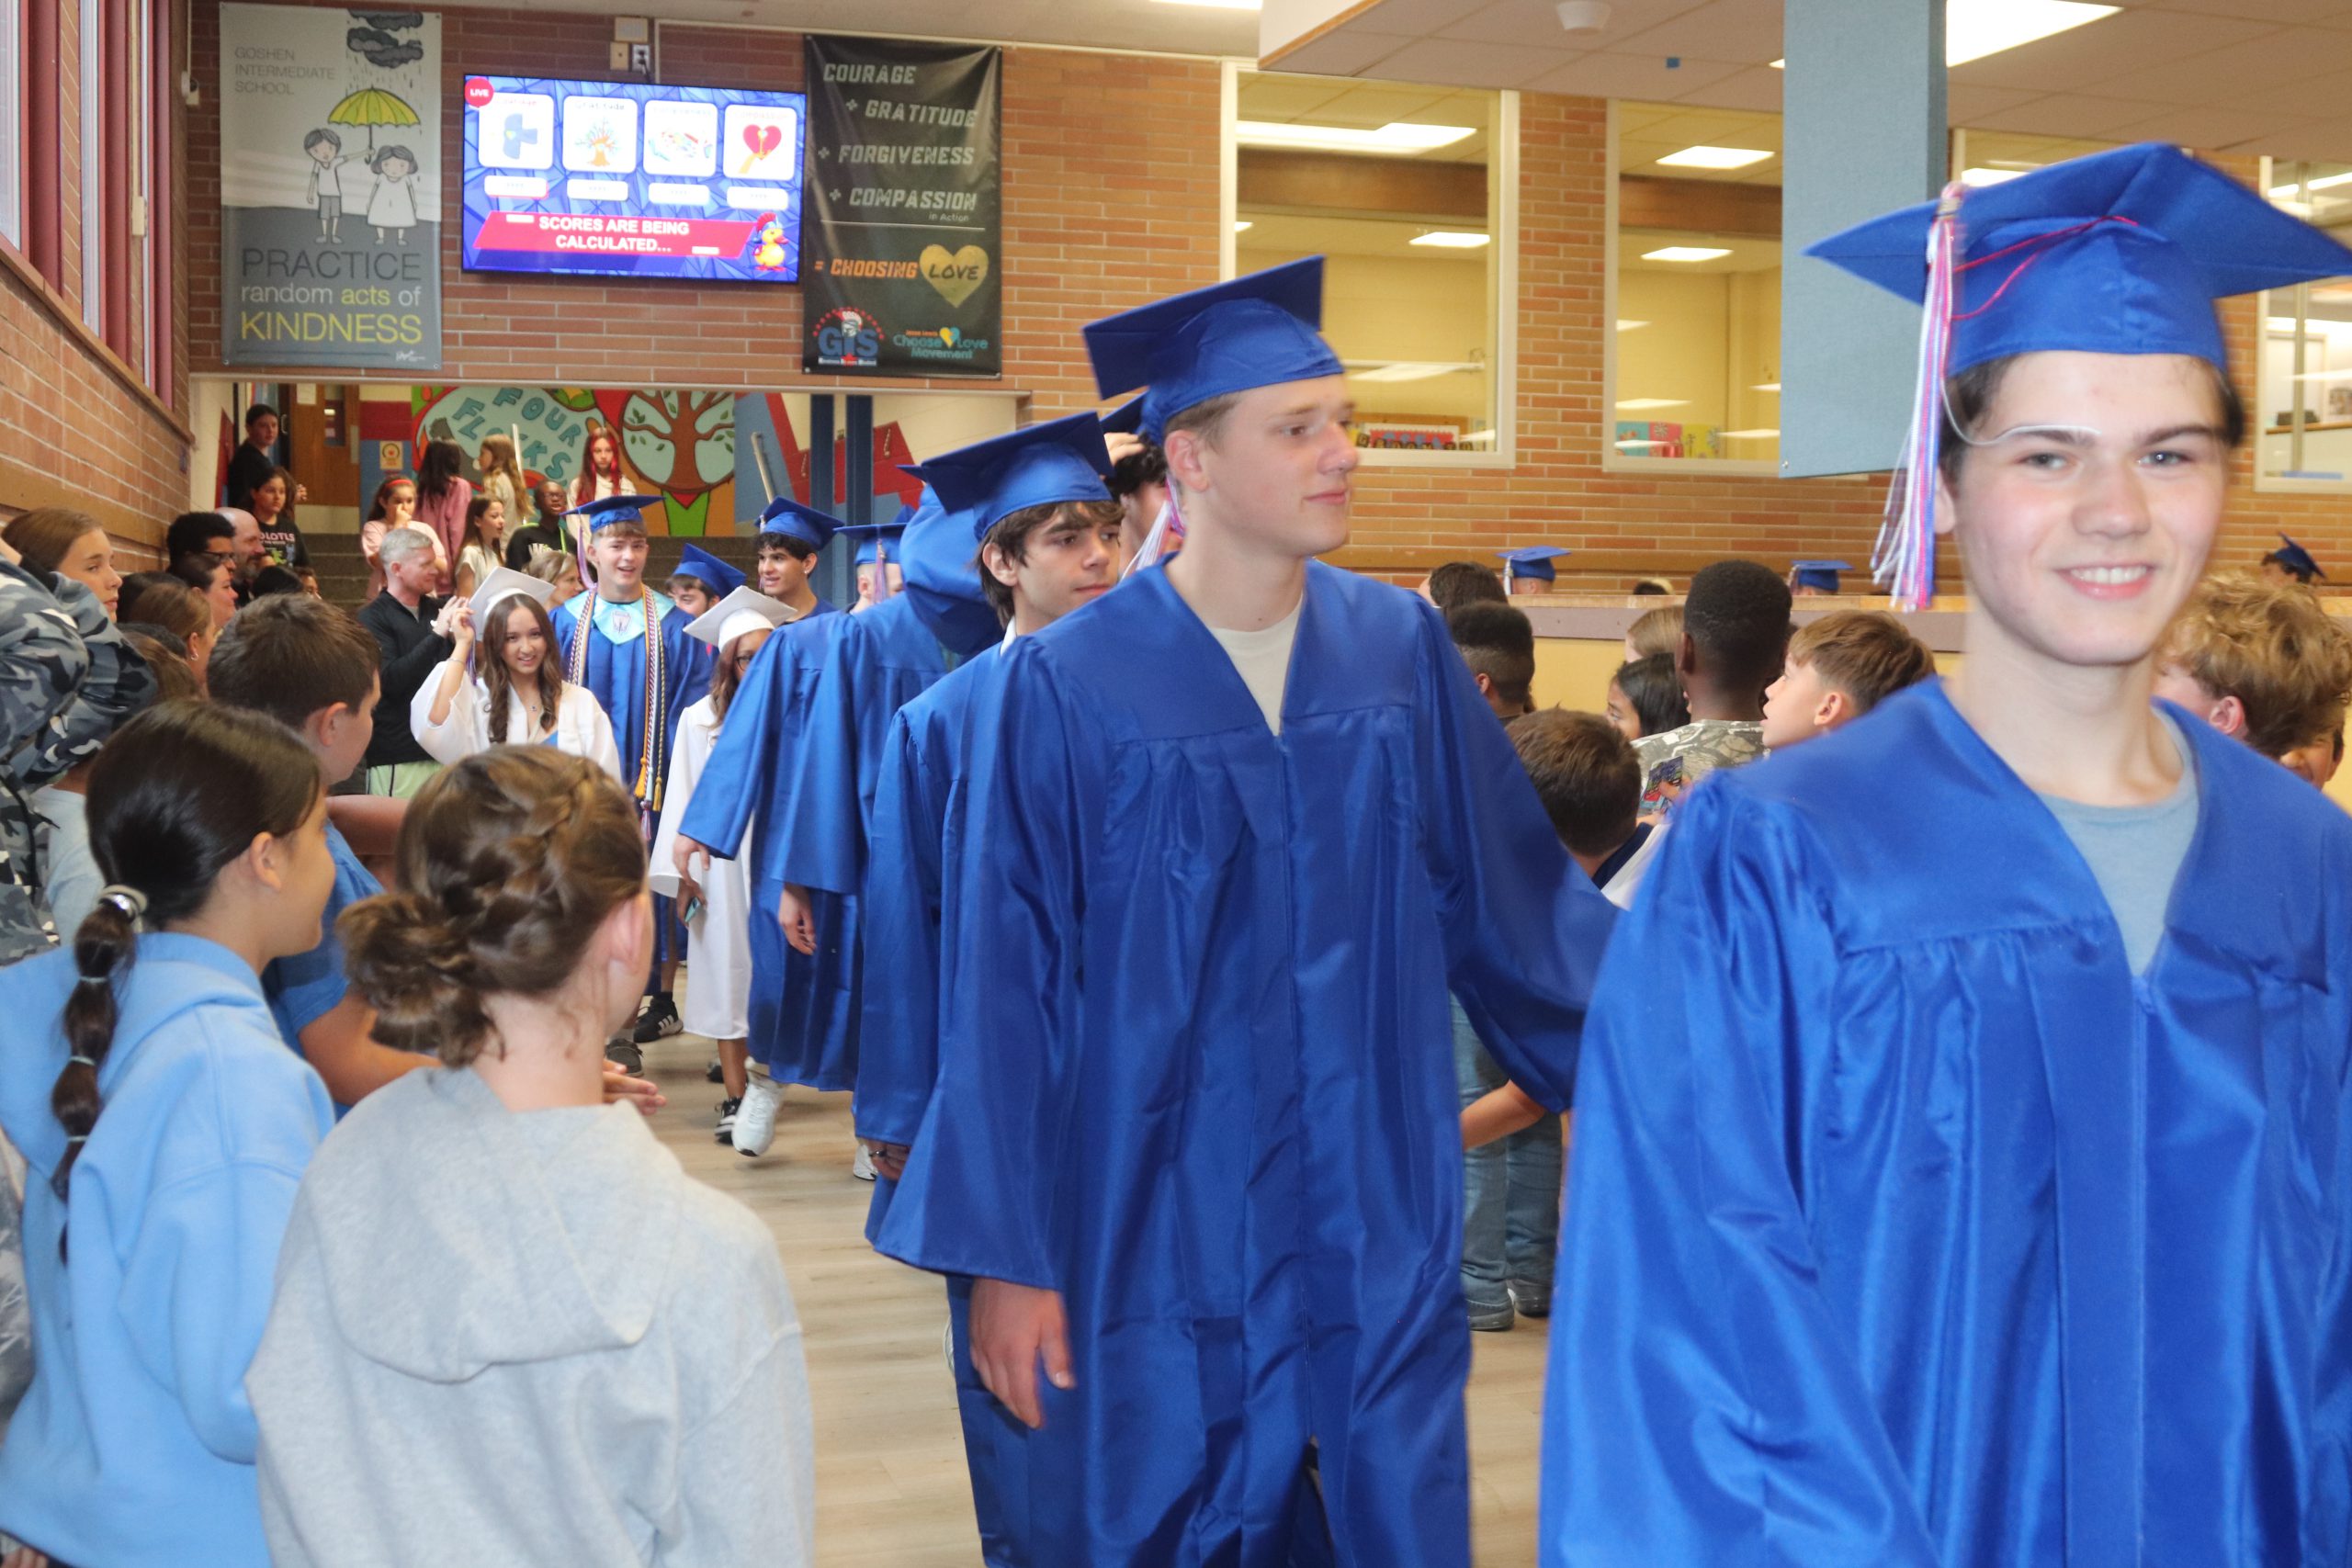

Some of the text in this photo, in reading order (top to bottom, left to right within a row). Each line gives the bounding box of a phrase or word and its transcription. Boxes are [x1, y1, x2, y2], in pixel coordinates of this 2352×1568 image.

[234, 46, 295, 62] GOSHEN
[234, 63, 335, 81] INTERMEDIATE
[823, 63, 917, 85] COURAGE
[234, 79, 295, 96] SCHOOL
[469, 88, 490, 97] LIVE
[865, 100, 977, 128] GRATITUDE
[838, 144, 975, 165] FORGIVENESS
[849, 187, 978, 211] COMPASSION
[539, 216, 690, 235] SCORES ARE BEING
[939, 213, 969, 221] Action
[555, 234, 673, 253] CALCULATED...
[242, 248, 422, 281] PRACTICE
[831, 258, 918, 279] CHOOSING
[928, 263, 979, 280] LOVE
[241, 284, 422, 306] random acts of
[241, 311, 423, 344] KINDNESS
[893, 333, 989, 349] Choose Love
[910, 347, 974, 360] Movement
[492, 387, 582, 447] FOUR
[451, 397, 572, 479] FLKS
